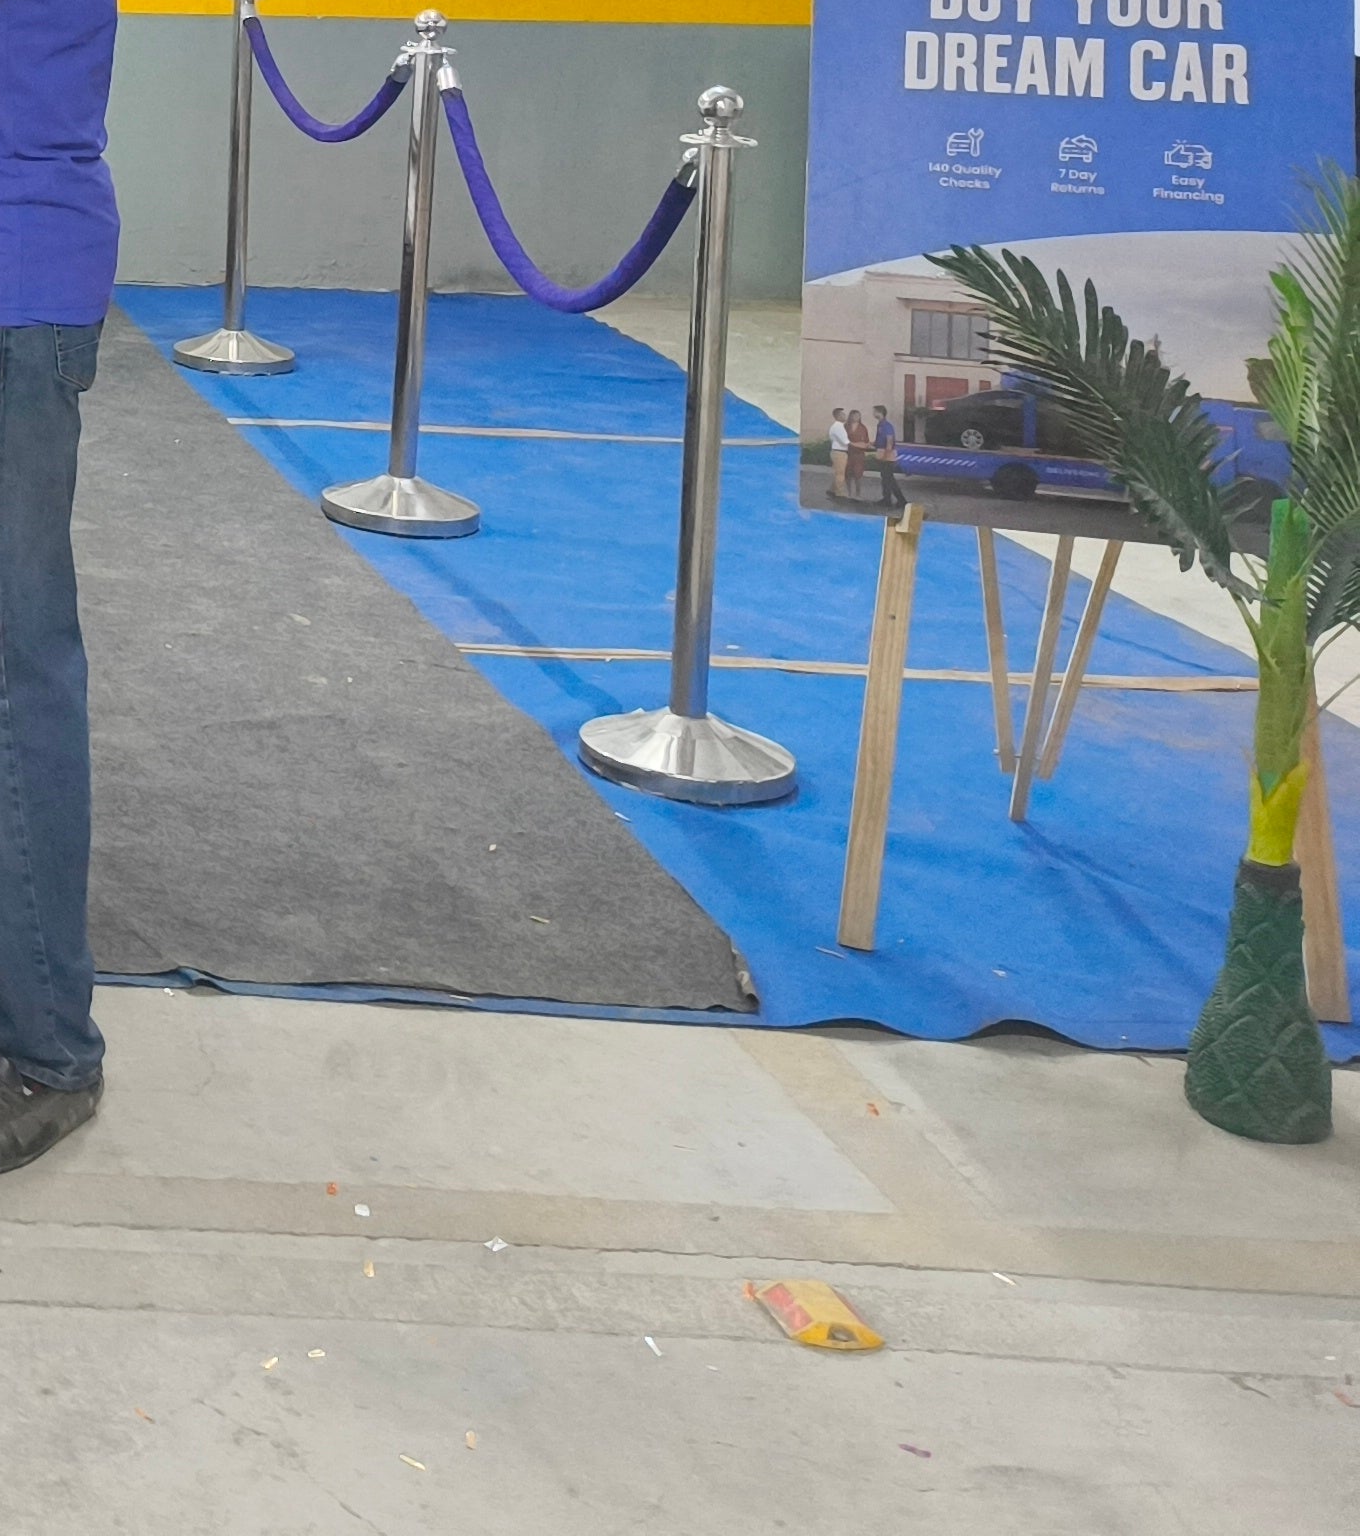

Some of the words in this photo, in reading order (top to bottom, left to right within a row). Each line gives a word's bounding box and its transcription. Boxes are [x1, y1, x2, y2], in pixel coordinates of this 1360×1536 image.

[903, 30, 1105, 99] DREAM
[1129, 38, 1250, 106] CAR
[928, 162, 950, 172] 140
[952, 164, 1002, 178] Quality
[1059, 168, 1066, 179] 7
[1068, 169, 1098, 183] Day
[939, 177, 990, 189] Checks
[1050, 182, 1105, 195] Returns
[1172, 175, 1206, 189] Easy
[1152, 187, 1225, 205] Financing
